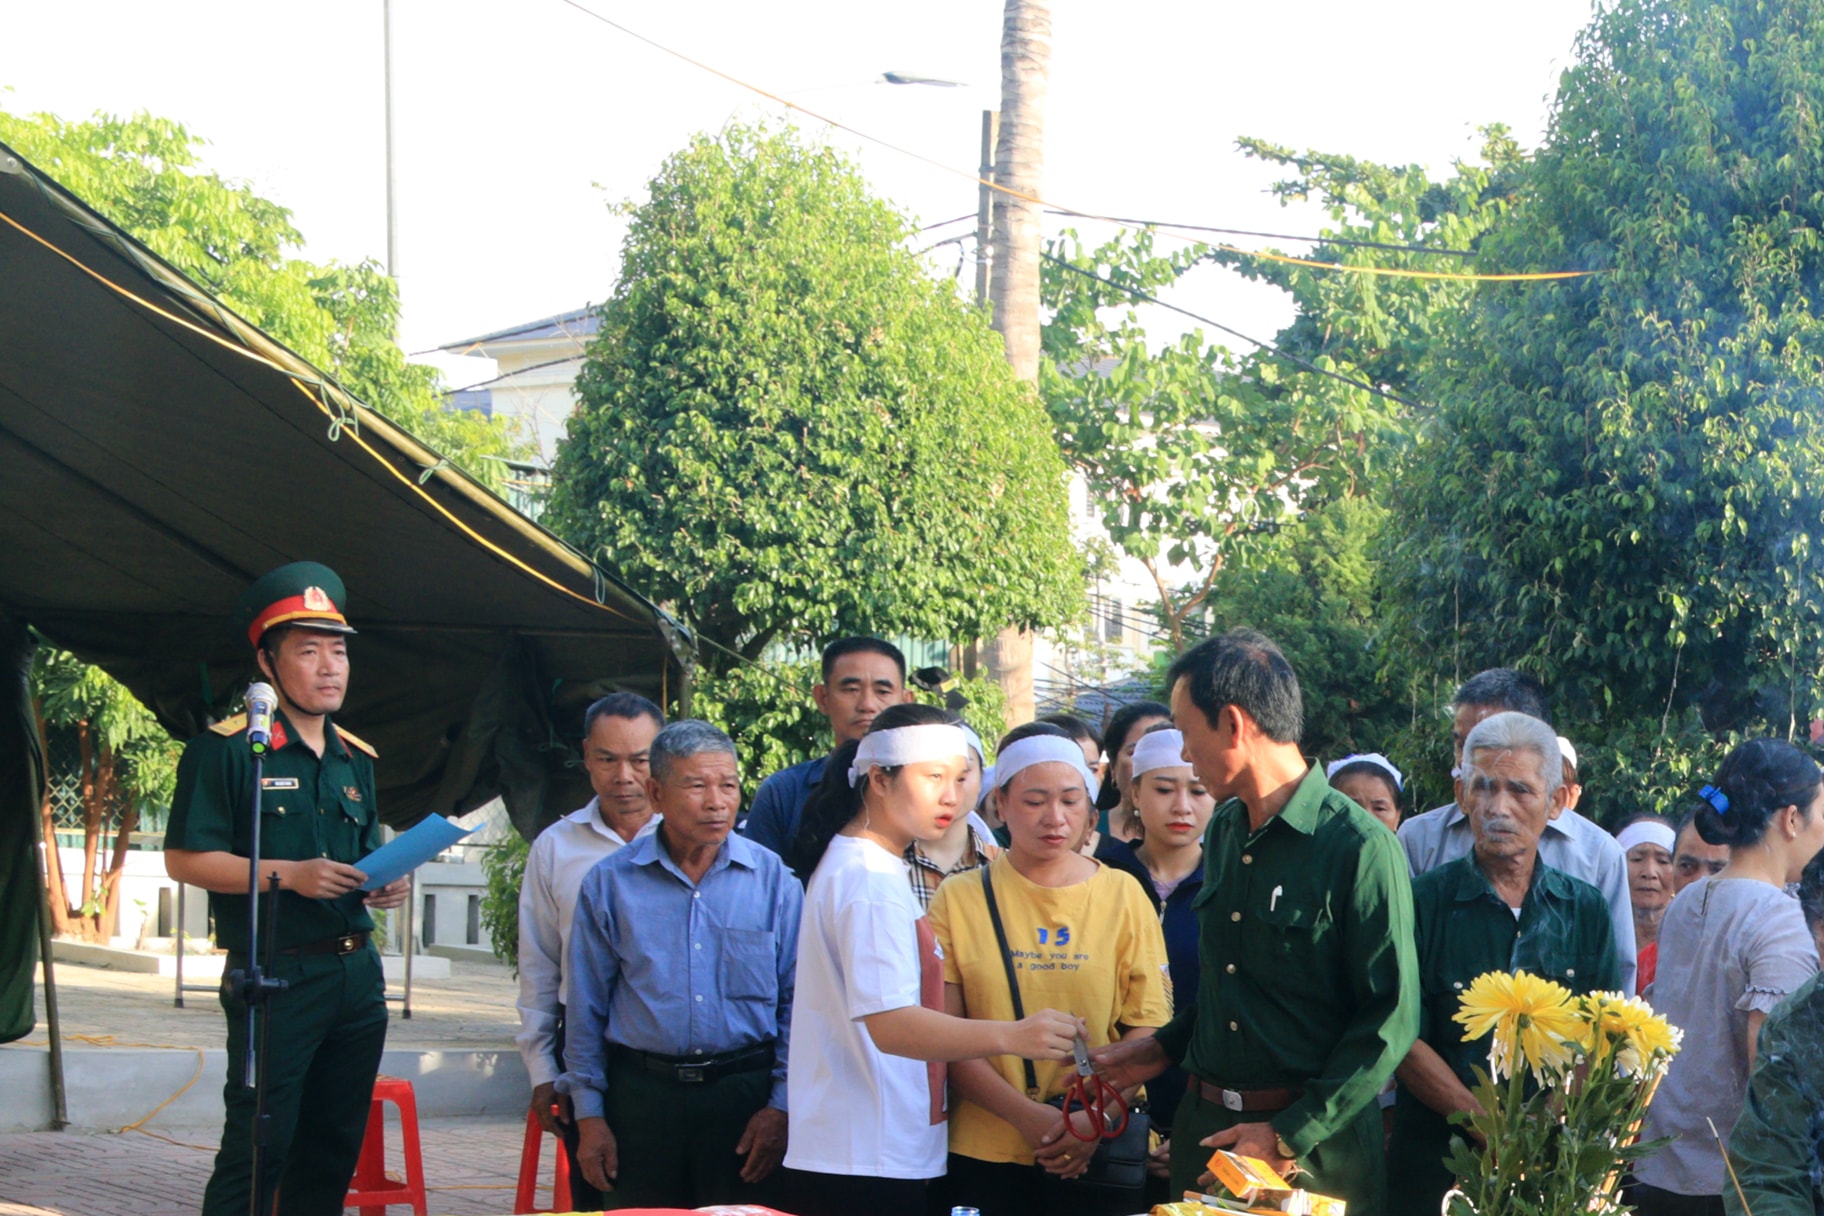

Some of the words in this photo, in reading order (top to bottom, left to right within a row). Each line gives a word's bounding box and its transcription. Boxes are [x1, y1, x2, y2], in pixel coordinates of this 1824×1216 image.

[1010, 950, 1042, 960] Maybe
[1050, 952, 1067, 961] you
[1030, 962, 1055, 971] good
[1061, 962, 1079, 971] boy
